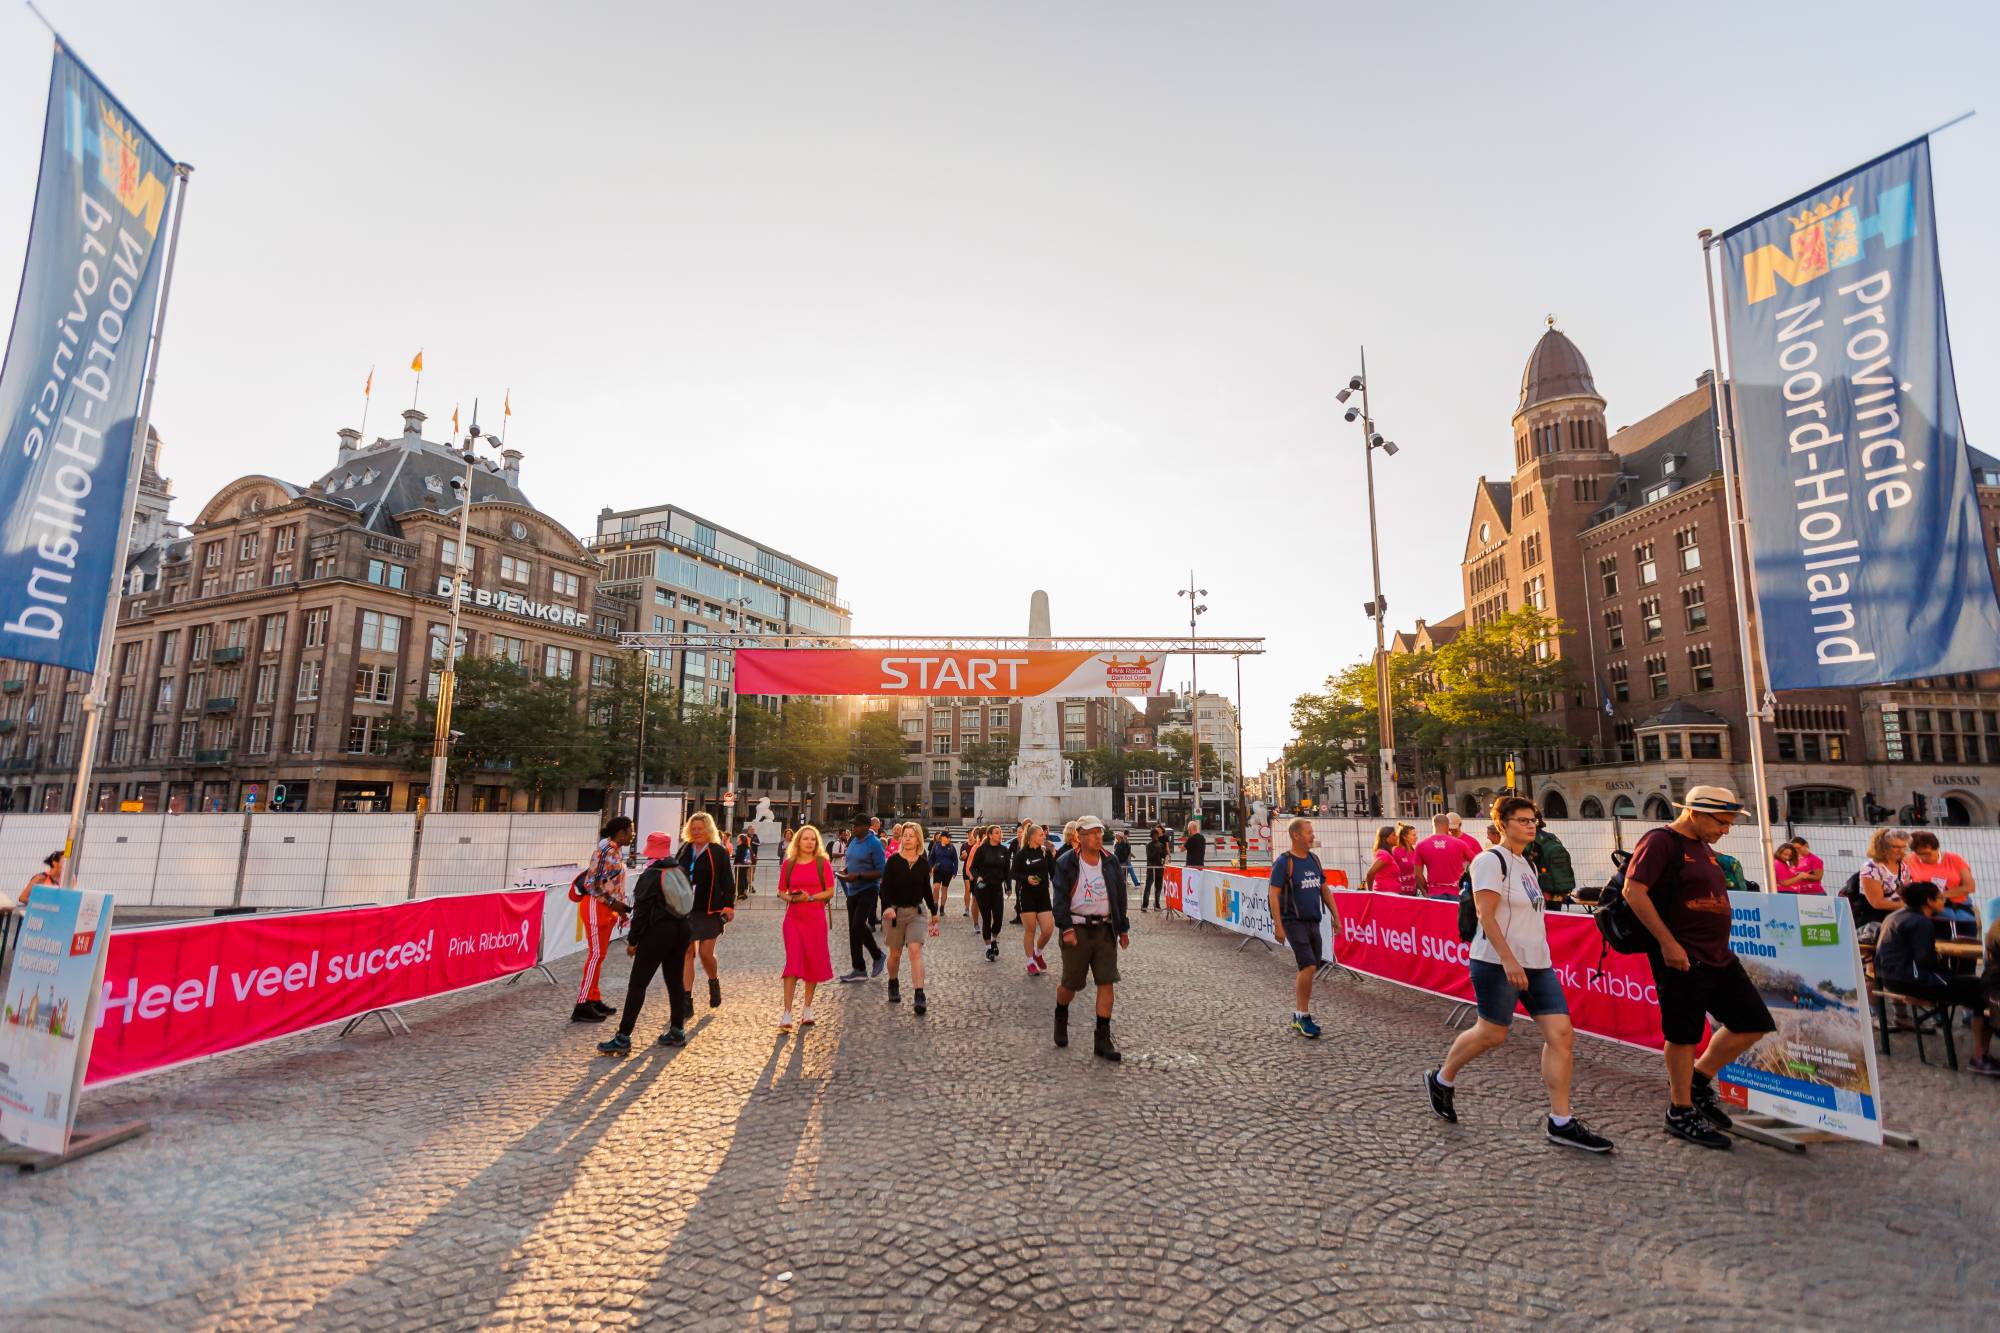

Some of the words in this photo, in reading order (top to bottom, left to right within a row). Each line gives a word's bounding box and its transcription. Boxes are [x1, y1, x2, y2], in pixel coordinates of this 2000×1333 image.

[1775, 296, 1876, 667] Noord-Holland
[437, 579, 473, 603] DE
[880, 657, 1029, 690] START
[1605, 780, 1635, 790] GASSAN
[1933, 775, 1981, 785] GASSAN
[448, 935, 476, 958] Pink
[478, 928, 519, 953] Ribbon
[1344, 917, 1377, 947] Heel
[1380, 926, 1418, 955] veel
[96, 965, 219, 1028] Heel
[230, 950, 318, 1002] veel
[326, 929, 434, 983] succes!
